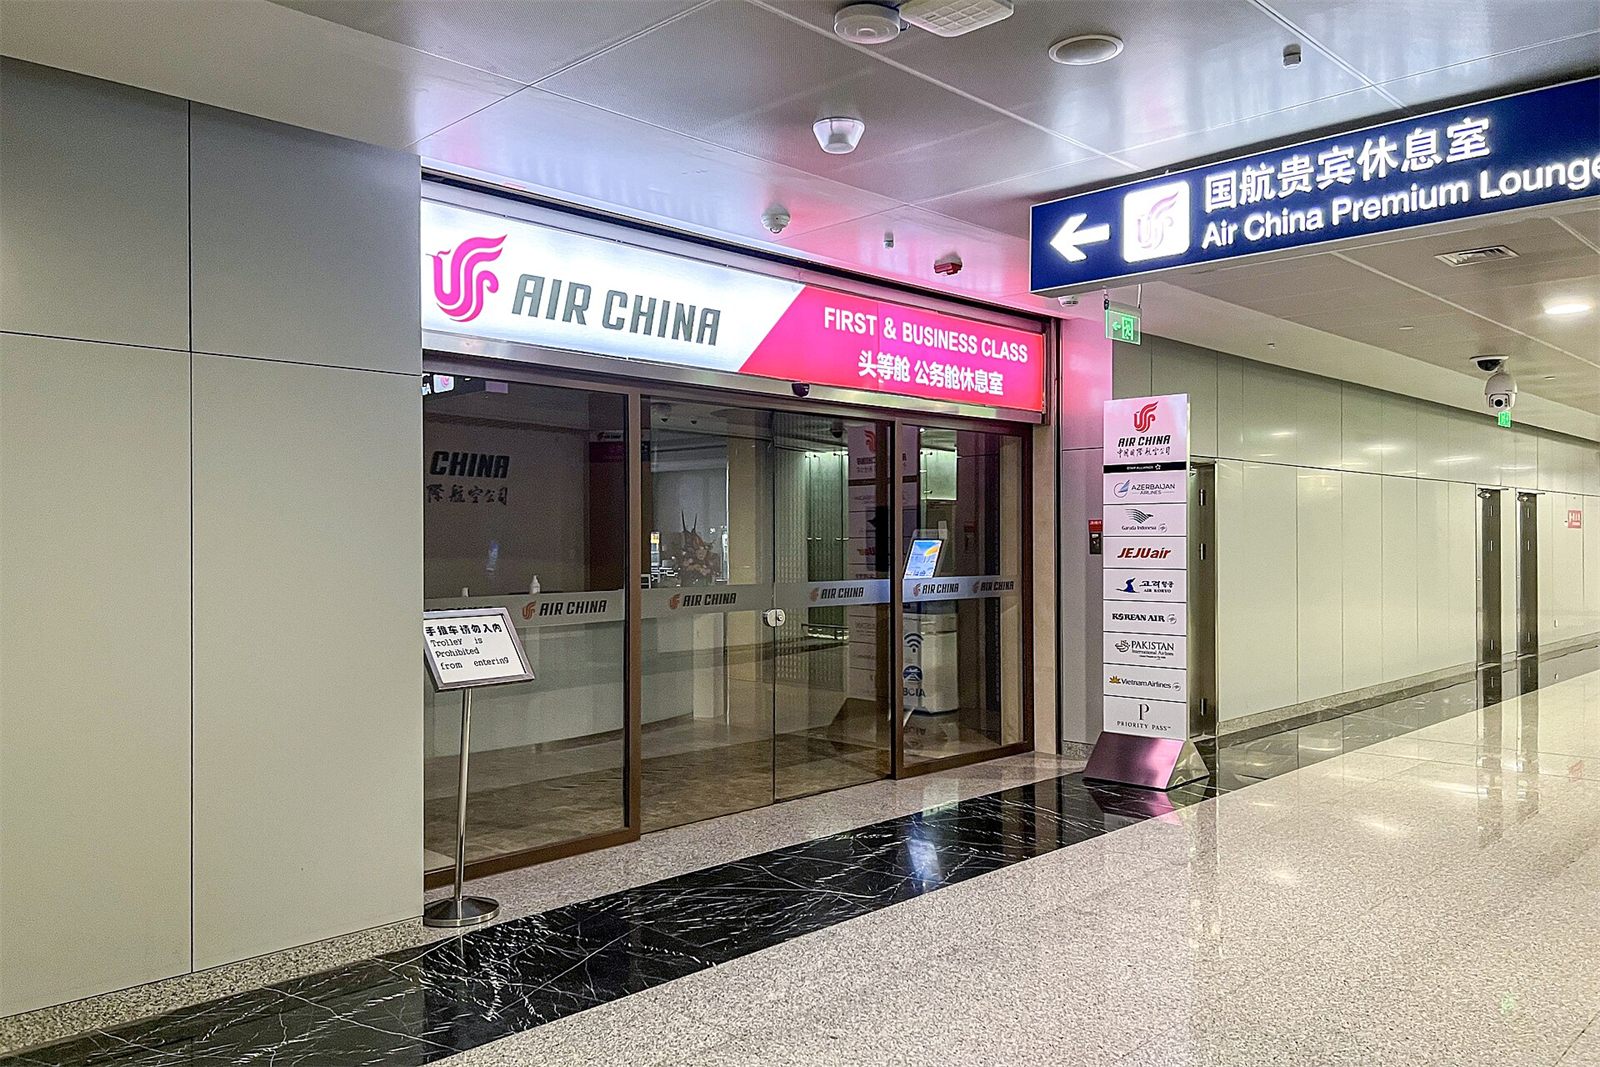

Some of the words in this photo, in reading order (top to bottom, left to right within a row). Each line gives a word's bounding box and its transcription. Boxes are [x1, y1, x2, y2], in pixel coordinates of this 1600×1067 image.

[1204, 117, 1491, 214] 国航贵宾休息室
[1201, 218, 1239, 250] Air
[1243, 206, 1324, 242] China
[1331, 181, 1470, 226] Premium
[511, 273, 592, 326] AIR
[601, 289, 722, 347] CHINA
[824, 306, 878, 336] FIRST
[883, 317, 898, 341] &
[902, 321, 978, 355] BUSINESS
[981, 337, 1029, 364] CLASS
[858, 350, 911, 383] 头等舱
[914, 359, 1005, 397] 公务舱休息室
[1117, 437, 1137, 448] AIR
[1138, 434, 1172, 446] CHINA
[430, 450, 511, 478] CHINA
[1131, 483, 1176, 491] AZERBAIJAN
[1117, 547, 1172, 559] JEJUair
[922, 583, 936, 594] AIR
[936, 582, 960, 594] CHINA
[980, 582, 993, 591] AIR
[993, 580, 1014, 591] CHINA
[682, 594, 703, 607] AIR
[703, 592, 737, 606] CHINA
[821, 588, 837, 599] AIR
[838, 587, 865, 599] CHINA
[539, 602, 564, 616] AIR
[566, 600, 608, 615] CHINA
[1112, 613, 1147, 622] KOREAN
[425, 623, 503, 636] 手推车请勿入内
[474, 636, 484, 645] is
[1131, 641, 1175, 651] PAKISTAN
[435, 646, 480, 659] Prohibited
[440, 661, 463, 671] from
[473, 656, 509, 667] entering
[1117, 720, 1149, 729] PRIORITY
